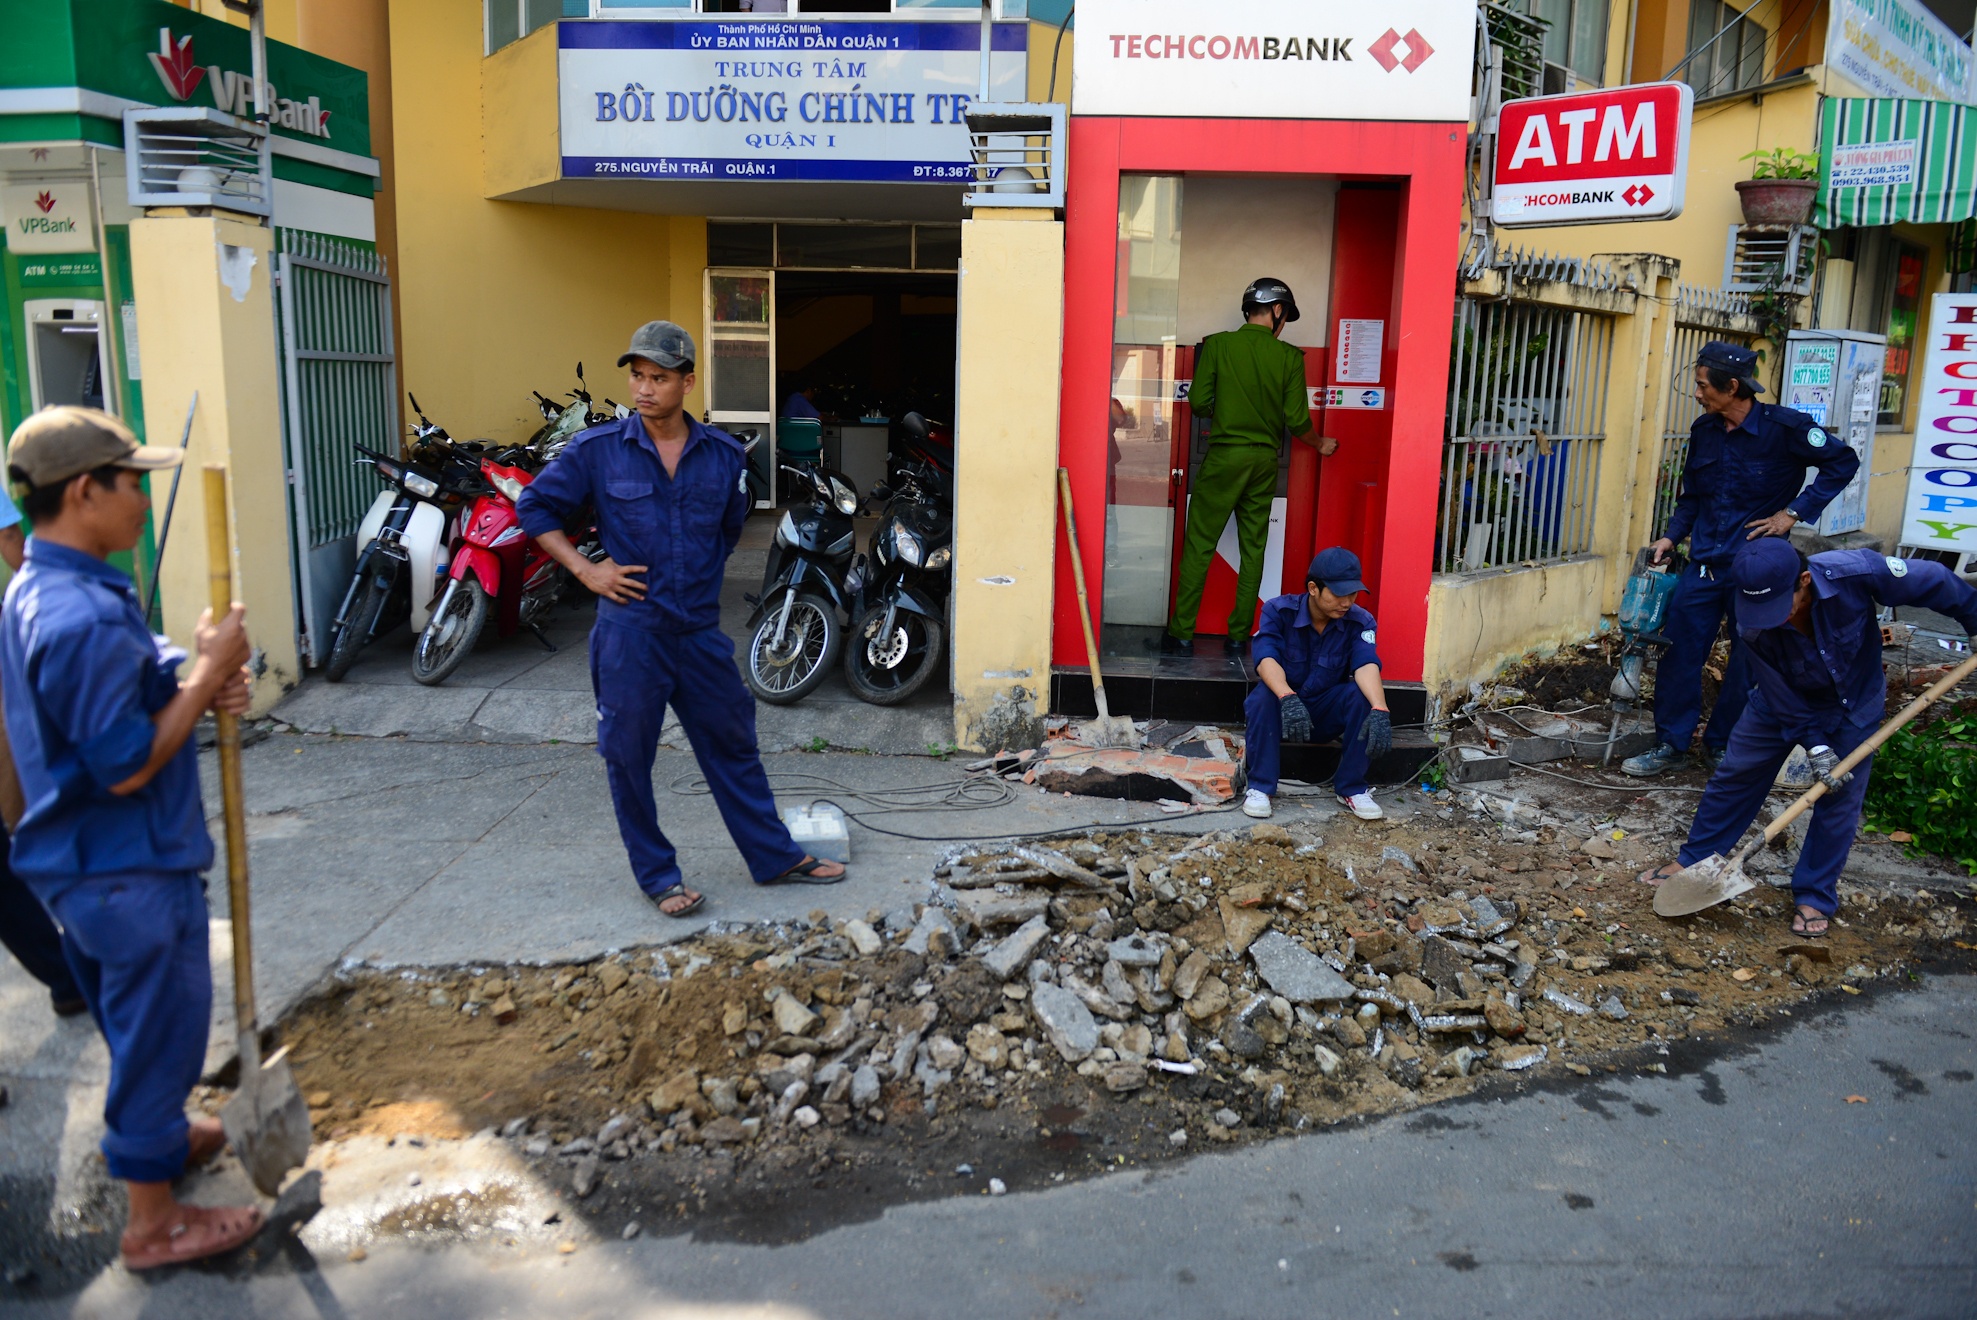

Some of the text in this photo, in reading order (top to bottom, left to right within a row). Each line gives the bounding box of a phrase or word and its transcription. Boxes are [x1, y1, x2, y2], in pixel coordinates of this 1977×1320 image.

[718, 24, 822, 34] Thành Phố Hồ Chí Minh
[691, 32, 899, 50] ỦY BAN NHÂN DÂN QUẬN 1
[1109, 34, 1354, 62] TECHCOMBANK
[715, 58, 867, 78] TRUNG TÂM
[207, 65, 332, 138] VPBank
[595, 83, 982, 124] BỒI DƯỠNG CHÍNH TR
[745, 131, 817, 149] QUẬN
[1508, 101, 1657, 170] ATM
[595, 159, 776, 176] 275.NGUYỄN TRÃI QUẬN.1
[1524, 190, 1614, 207] HCOMBANK
[19, 217, 76, 234] VPBank
[24, 265, 46, 277] ATM
